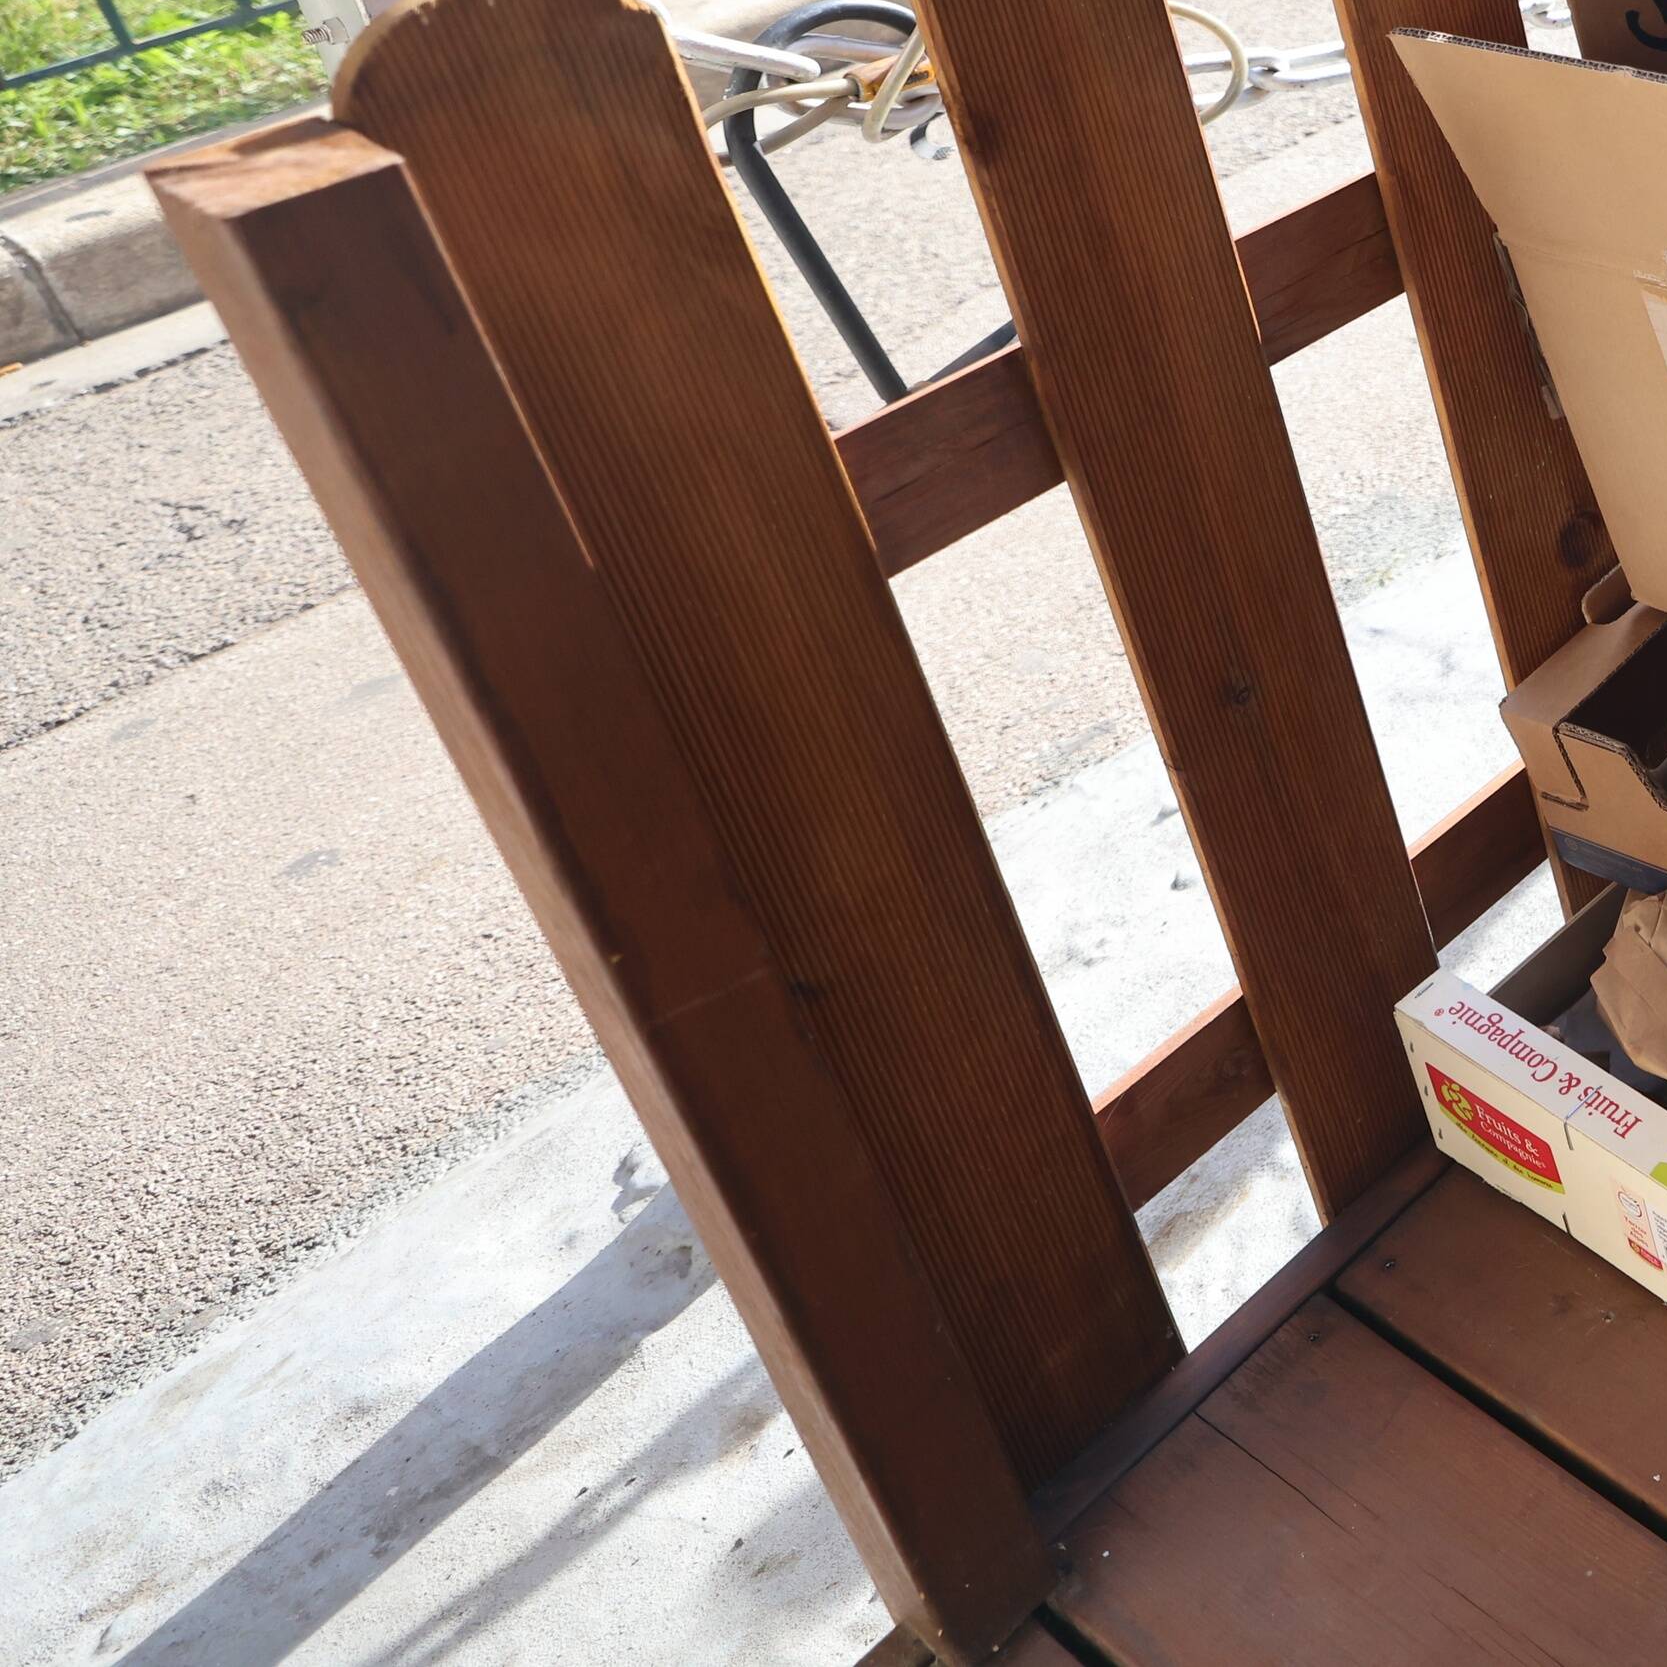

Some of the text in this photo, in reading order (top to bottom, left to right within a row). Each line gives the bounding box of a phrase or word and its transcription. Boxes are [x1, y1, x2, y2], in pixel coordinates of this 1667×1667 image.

[1558, 1072, 1582, 1096] &
[1474, 1103, 1540, 1157] Fruits &
[1577, 1084, 1644, 1140] Fruits
